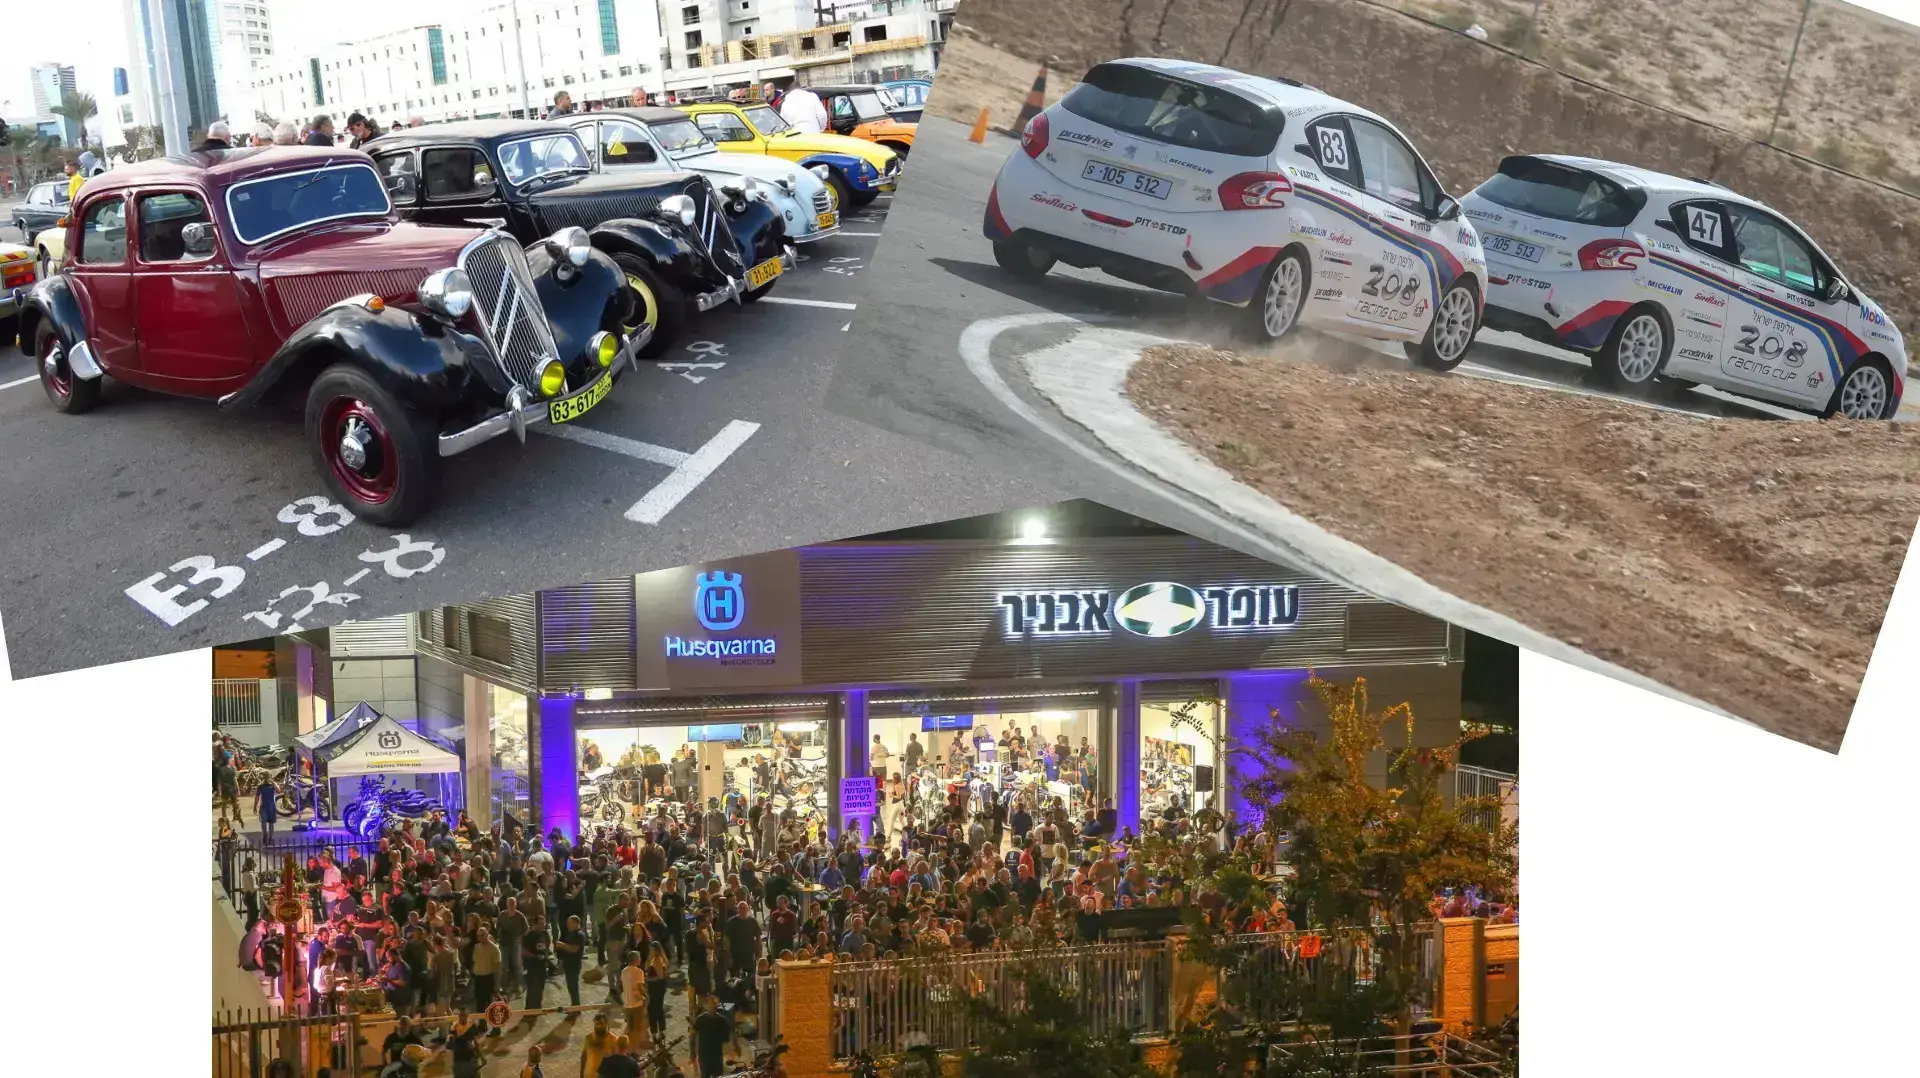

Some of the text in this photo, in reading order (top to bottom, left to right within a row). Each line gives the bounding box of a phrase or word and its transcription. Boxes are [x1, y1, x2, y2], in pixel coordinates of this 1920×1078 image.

[1059, 130, 1114, 148] prodrive
[1320, 131, 1346, 165] 83
[1169, 159, 1214, 174] MICHELIN
[1297, 169, 1320, 182] VARTA
[1101, 167, 1125, 184] 105
[1133, 175, 1161, 194] 512
[1135, 217, 1188, 236] PIT STOP
[1299, 226, 1328, 237] MICHELIN
[1533, 229, 1568, 241] MICHELIN
[1691, 211, 1719, 241] 47
[1492, 236, 1511, 250] 105
[1515, 244, 1535, 258] 513
[1657, 241, 1680, 253] VARTA
[1361, 263, 1420, 306] 208
[1507, 273, 1552, 290] PIT STOP
[1647, 280, 1683, 296] MICHELIN
[1752, 309, 1773, 327] ישראל
[1860, 304, 1886, 327] Mobil
[1679, 348, 1714, 360] prodrive
[1733, 325, 1809, 368] 208
[1772, 368, 1797, 381] CUP
[552, 389, 595, 421] 63-617
[124, 495, 356, 627] E3-8
[999, 586, 1300, 634] עופר אבניר
[665, 636, 776, 658] Husqvarna
[365, 749, 419, 757] Husqvarna
[846, 793, 870, 801] לשירות
